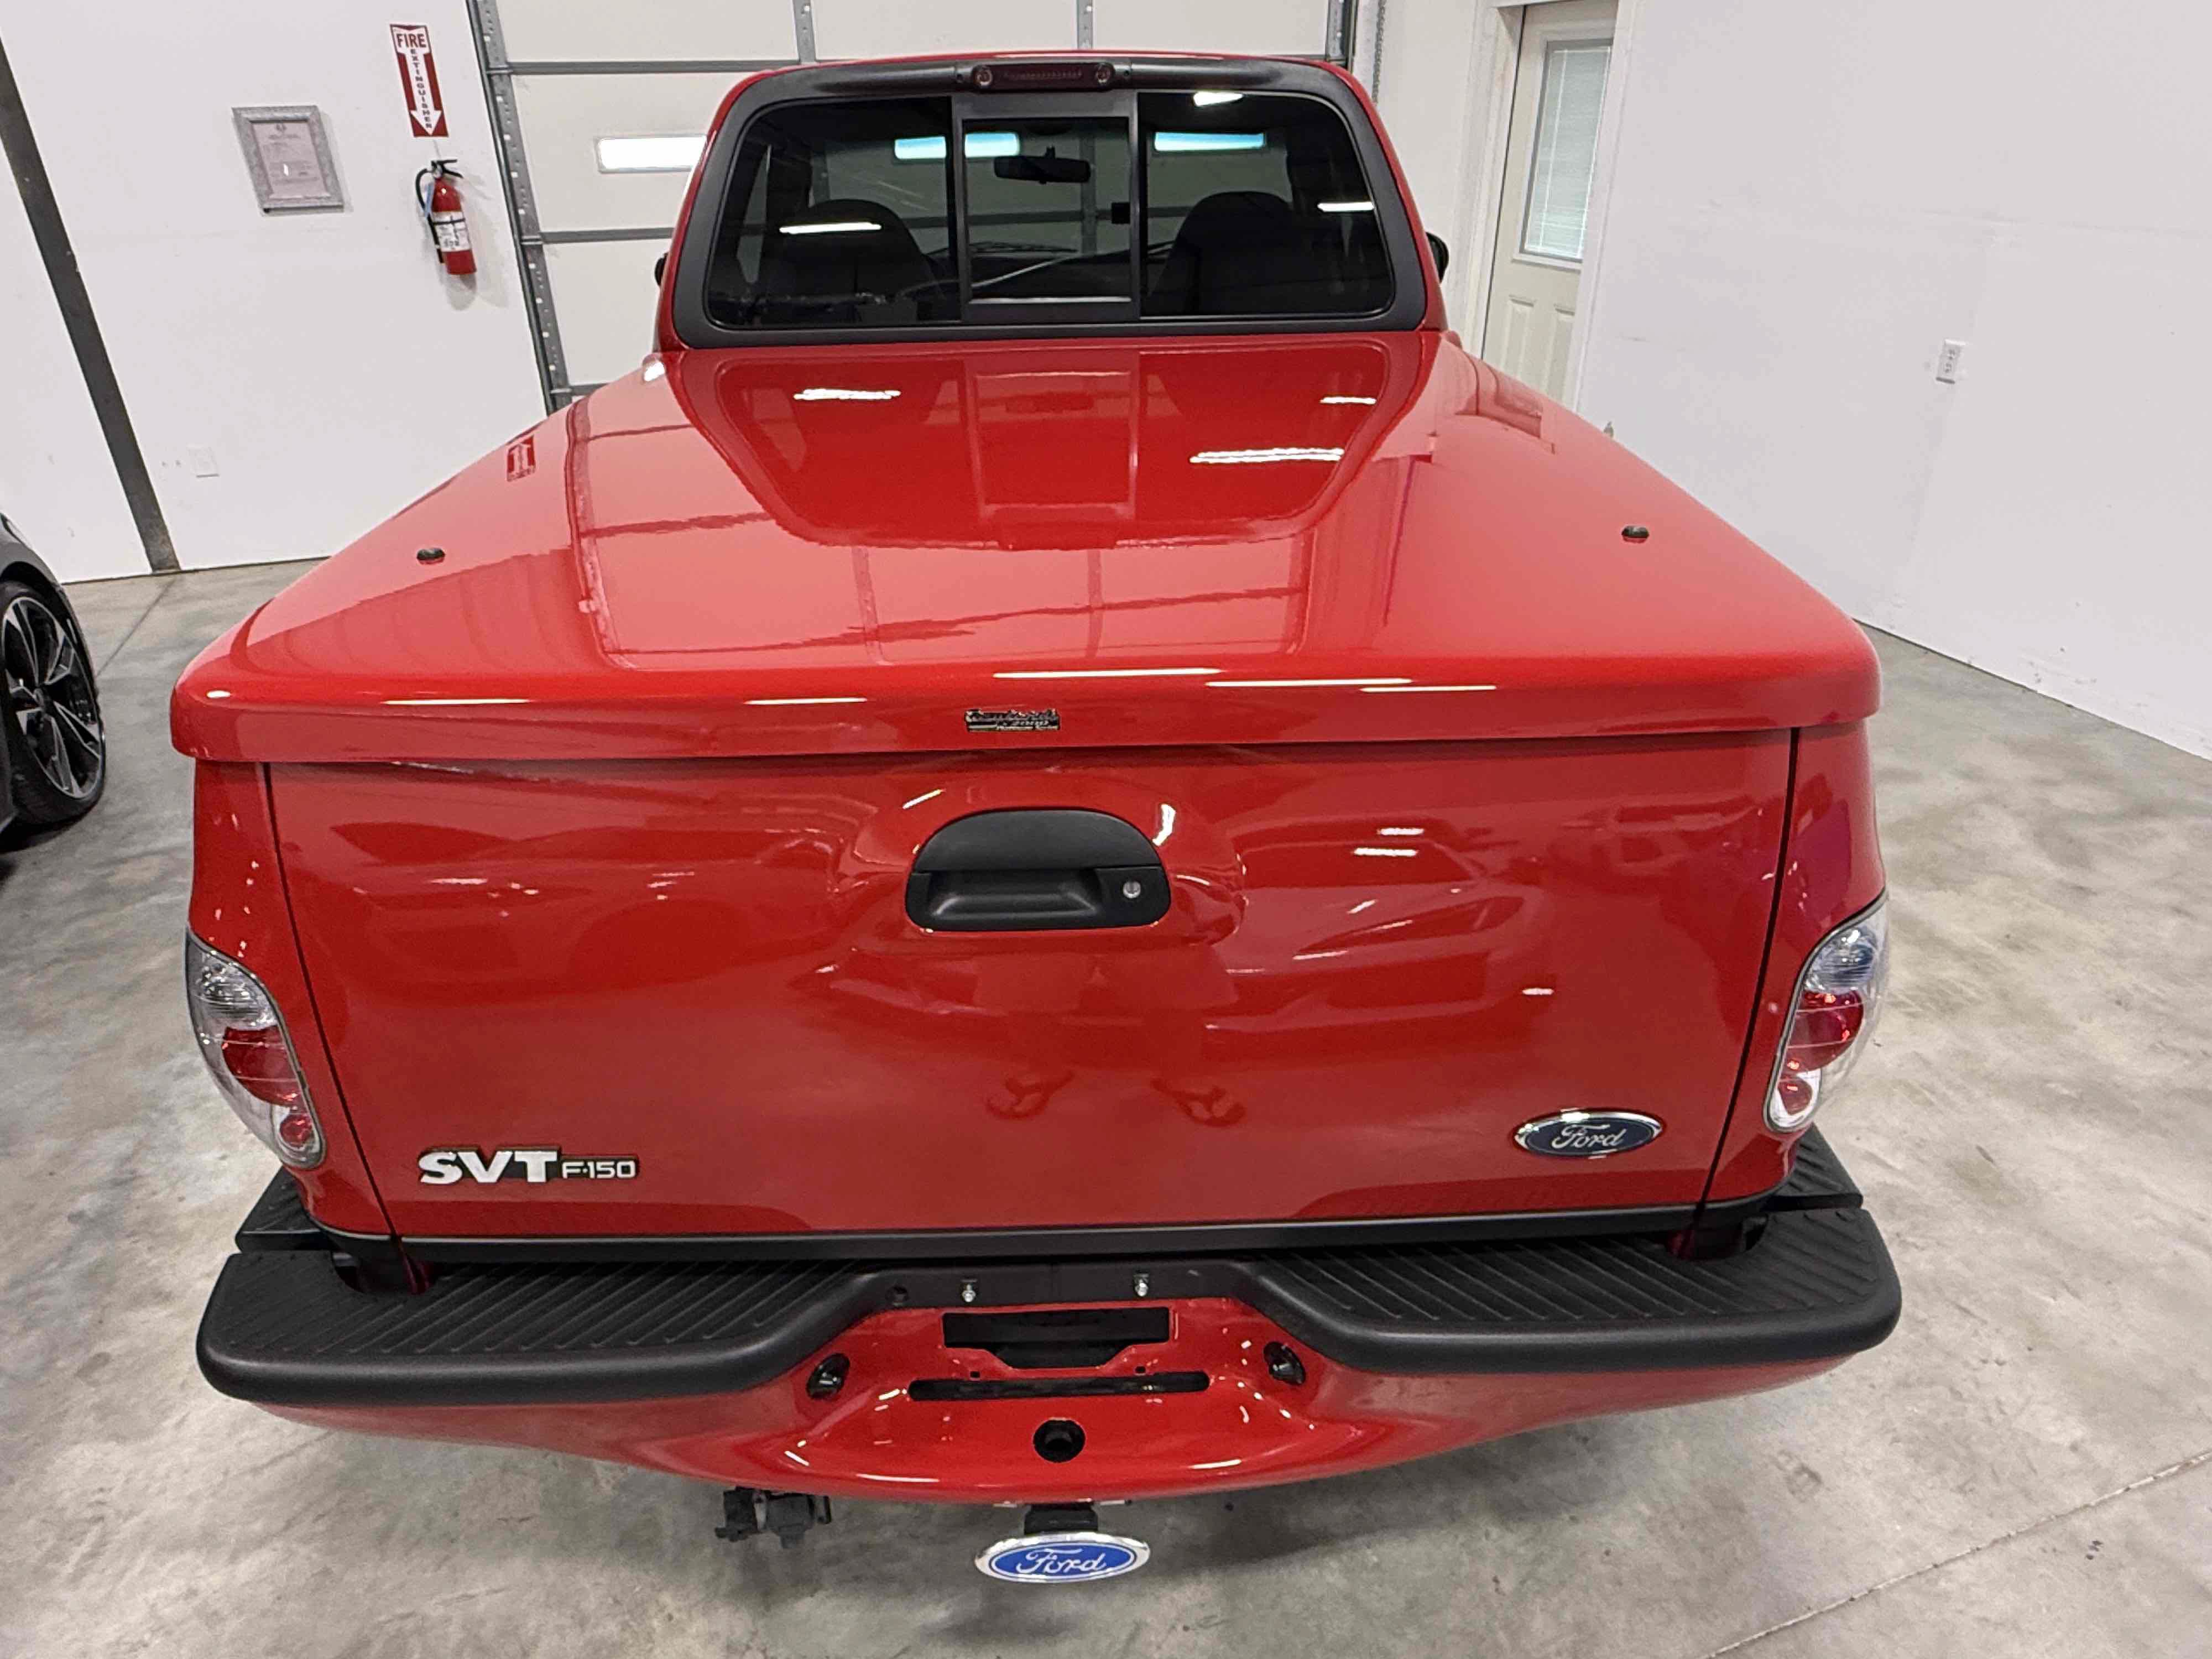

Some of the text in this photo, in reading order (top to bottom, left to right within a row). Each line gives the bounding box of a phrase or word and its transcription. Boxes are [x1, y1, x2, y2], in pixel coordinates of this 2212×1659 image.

[396, 33, 426, 48] FIRE
[1551, 1123, 1627, 1149] Ford
[419, 1150, 557, 1184] SVT
[1016, 1548, 1107, 1573] Ford
